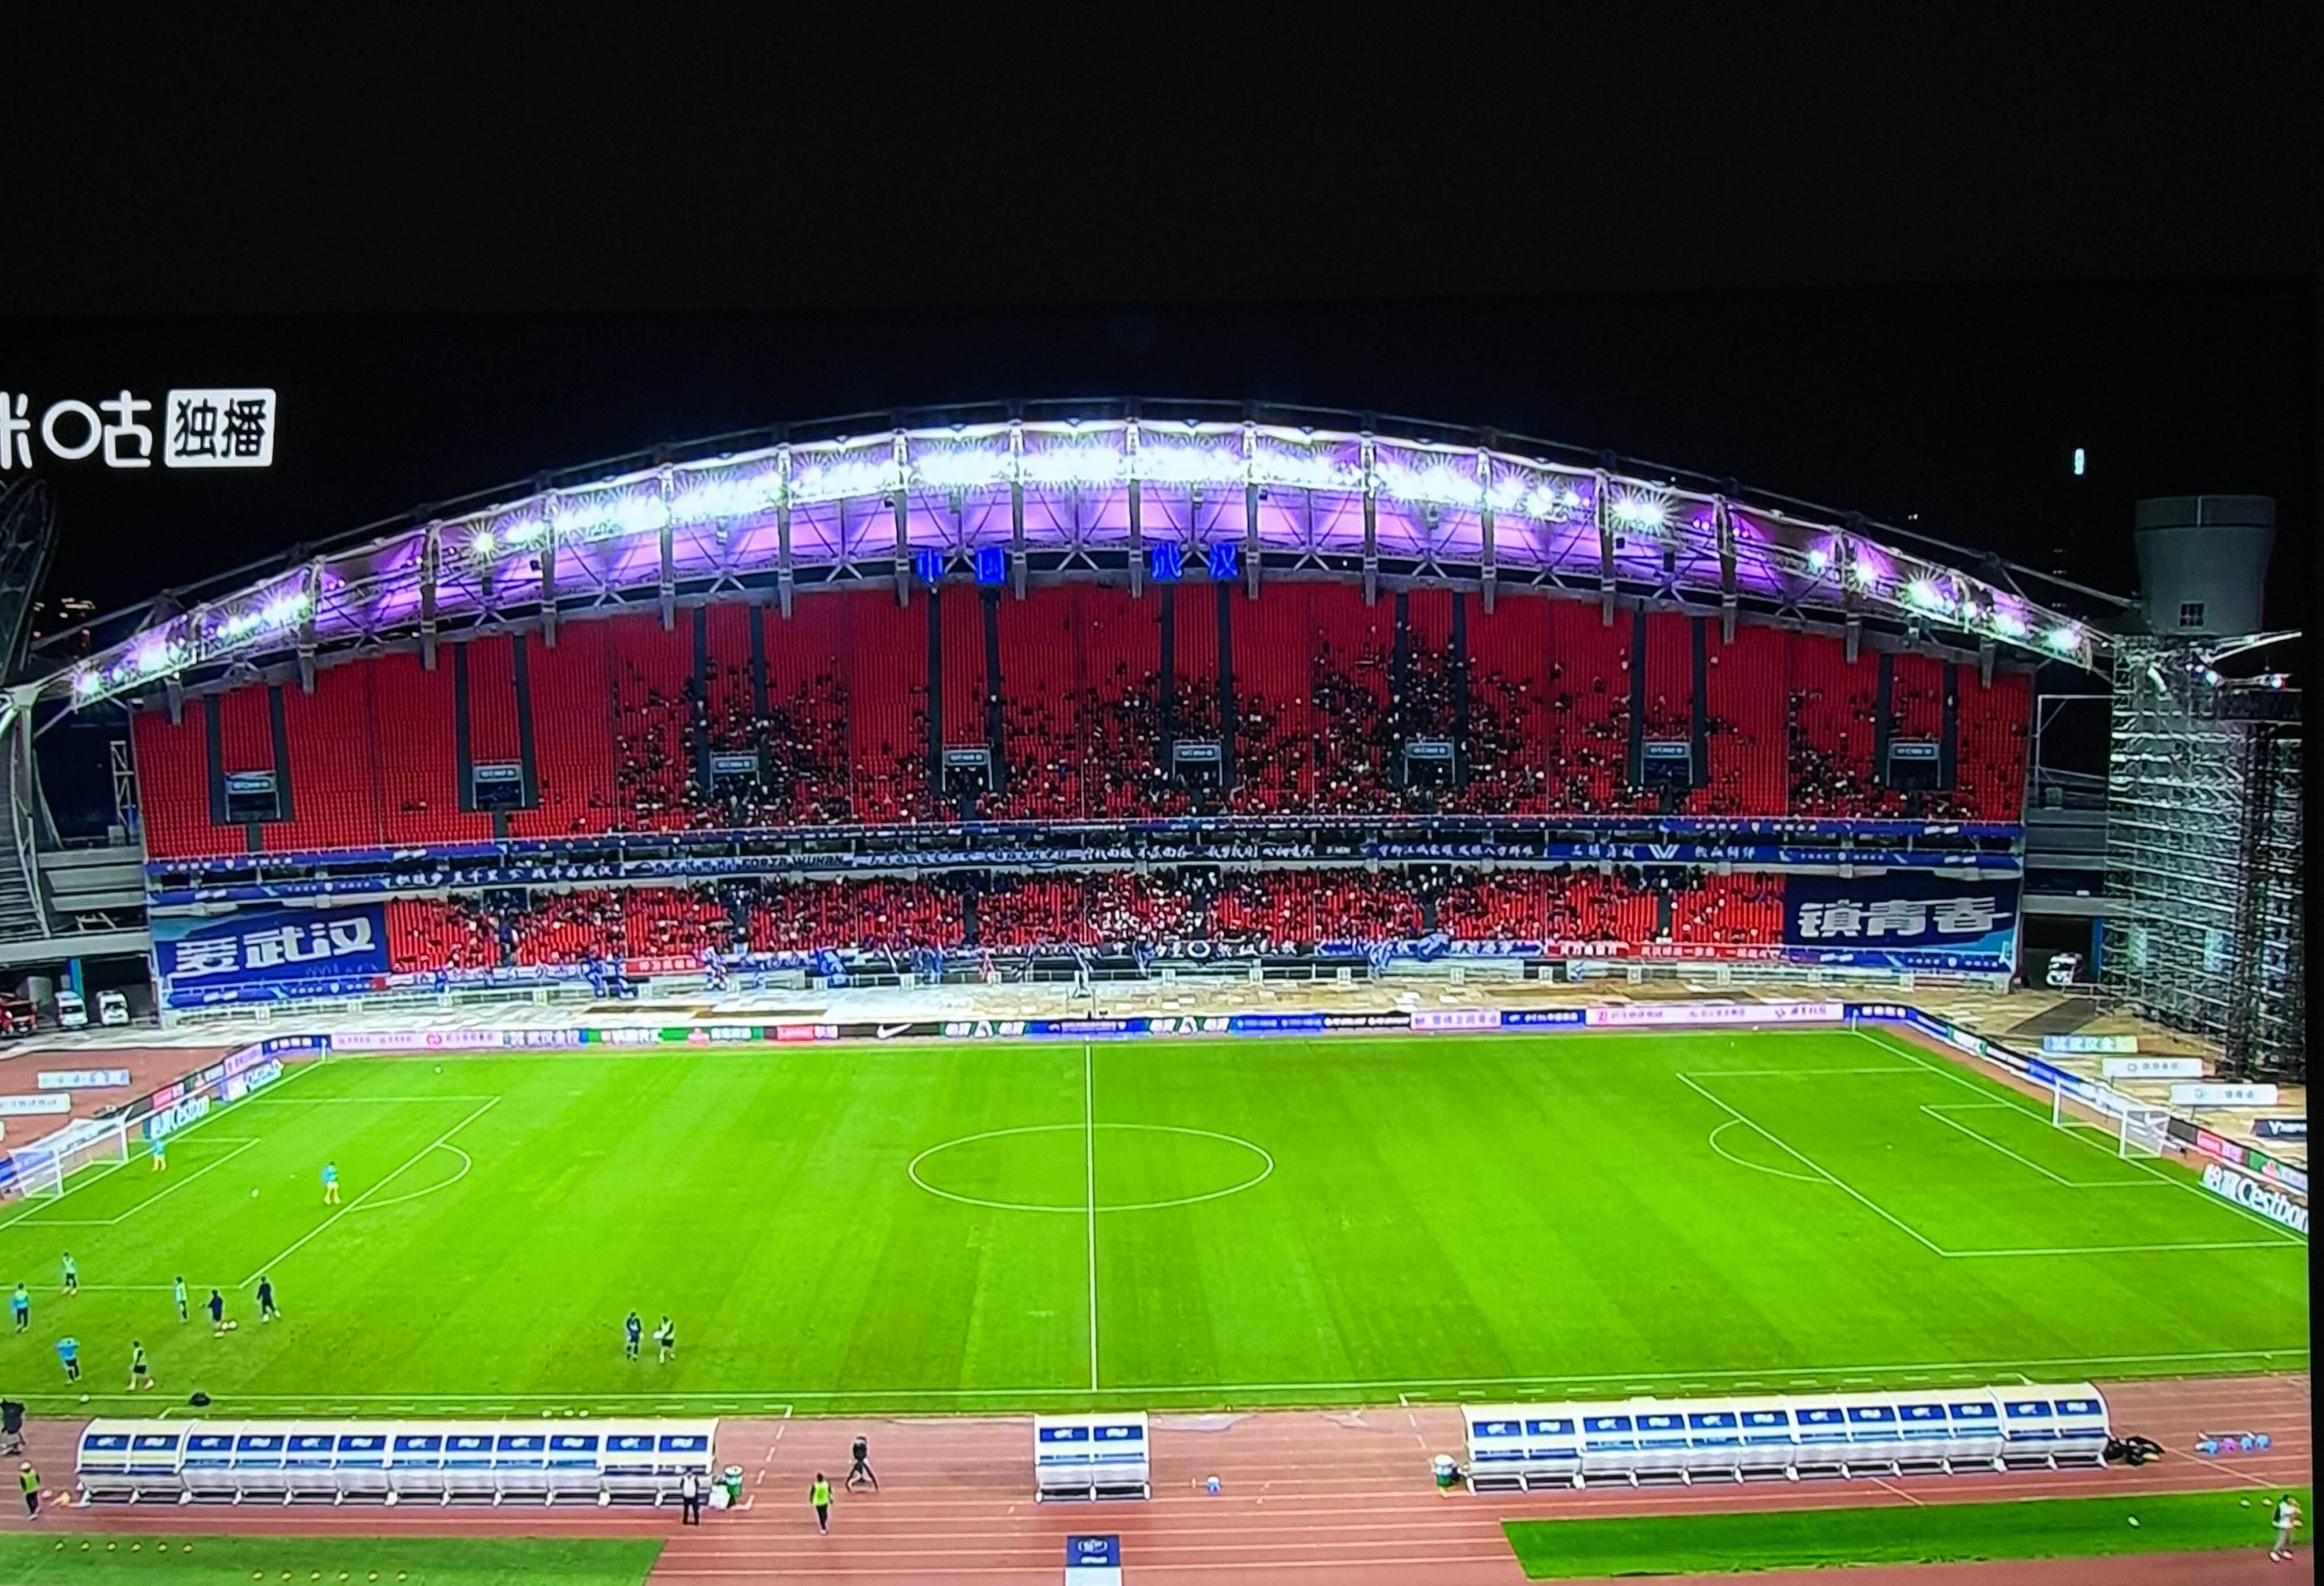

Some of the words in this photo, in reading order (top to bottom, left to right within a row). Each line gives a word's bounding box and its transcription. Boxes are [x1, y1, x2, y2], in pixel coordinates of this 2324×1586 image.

[1797, 896, 2013, 938] 镇青春
[166, 916, 376, 978] 爱武汉
